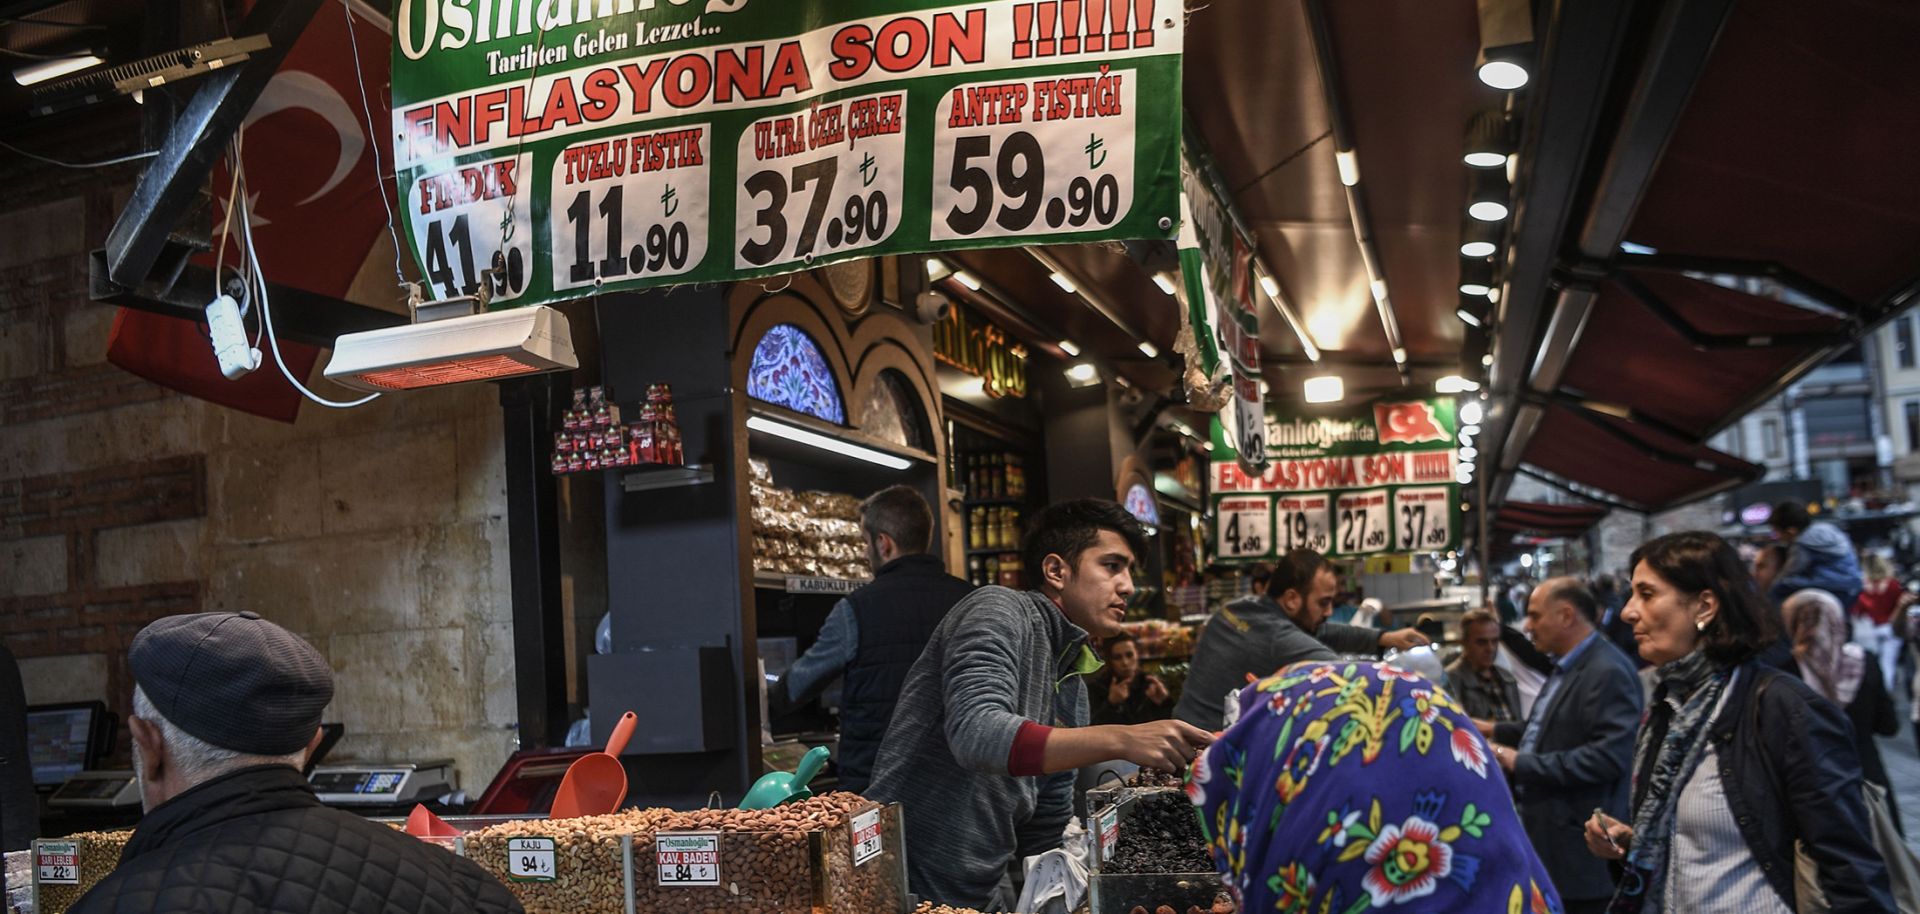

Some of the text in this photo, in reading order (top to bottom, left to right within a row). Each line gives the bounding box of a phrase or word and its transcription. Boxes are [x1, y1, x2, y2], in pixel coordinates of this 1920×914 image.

[487, 15, 721, 76] Tarihten Gelen Lezzet...
[403, 41, 813, 163] ENFLASYONA
[829, 9, 986, 81] SON
[948, 64, 1122, 129] ANTEP FISTIĞI
[754, 94, 902, 161] ULTRA ÖZEL ÇEREZ
[564, 128, 704, 184] TUZLU FISTIK
[419, 159, 517, 216] FINDIK
[945, 131, 1119, 235] 59.90
[740, 156, 888, 265] 37.90
[567, 185, 689, 283] 11.90
[1218, 455, 1356, 491] ENLASYONA
[1362, 454, 1406, 483] SON
[1225, 512, 1262, 555] 4.90
[1341, 510, 1384, 551] 27.90
[1401, 505, 1446, 548] 37.90
[800, 579, 846, 591] KABUKLU
[520, 840, 541, 849] KAJU
[521, 855, 537, 872] 94
[659, 852, 717, 864] KAV. BADEM
[53, 866, 65, 878] 22
[676, 864, 692, 880] 84
